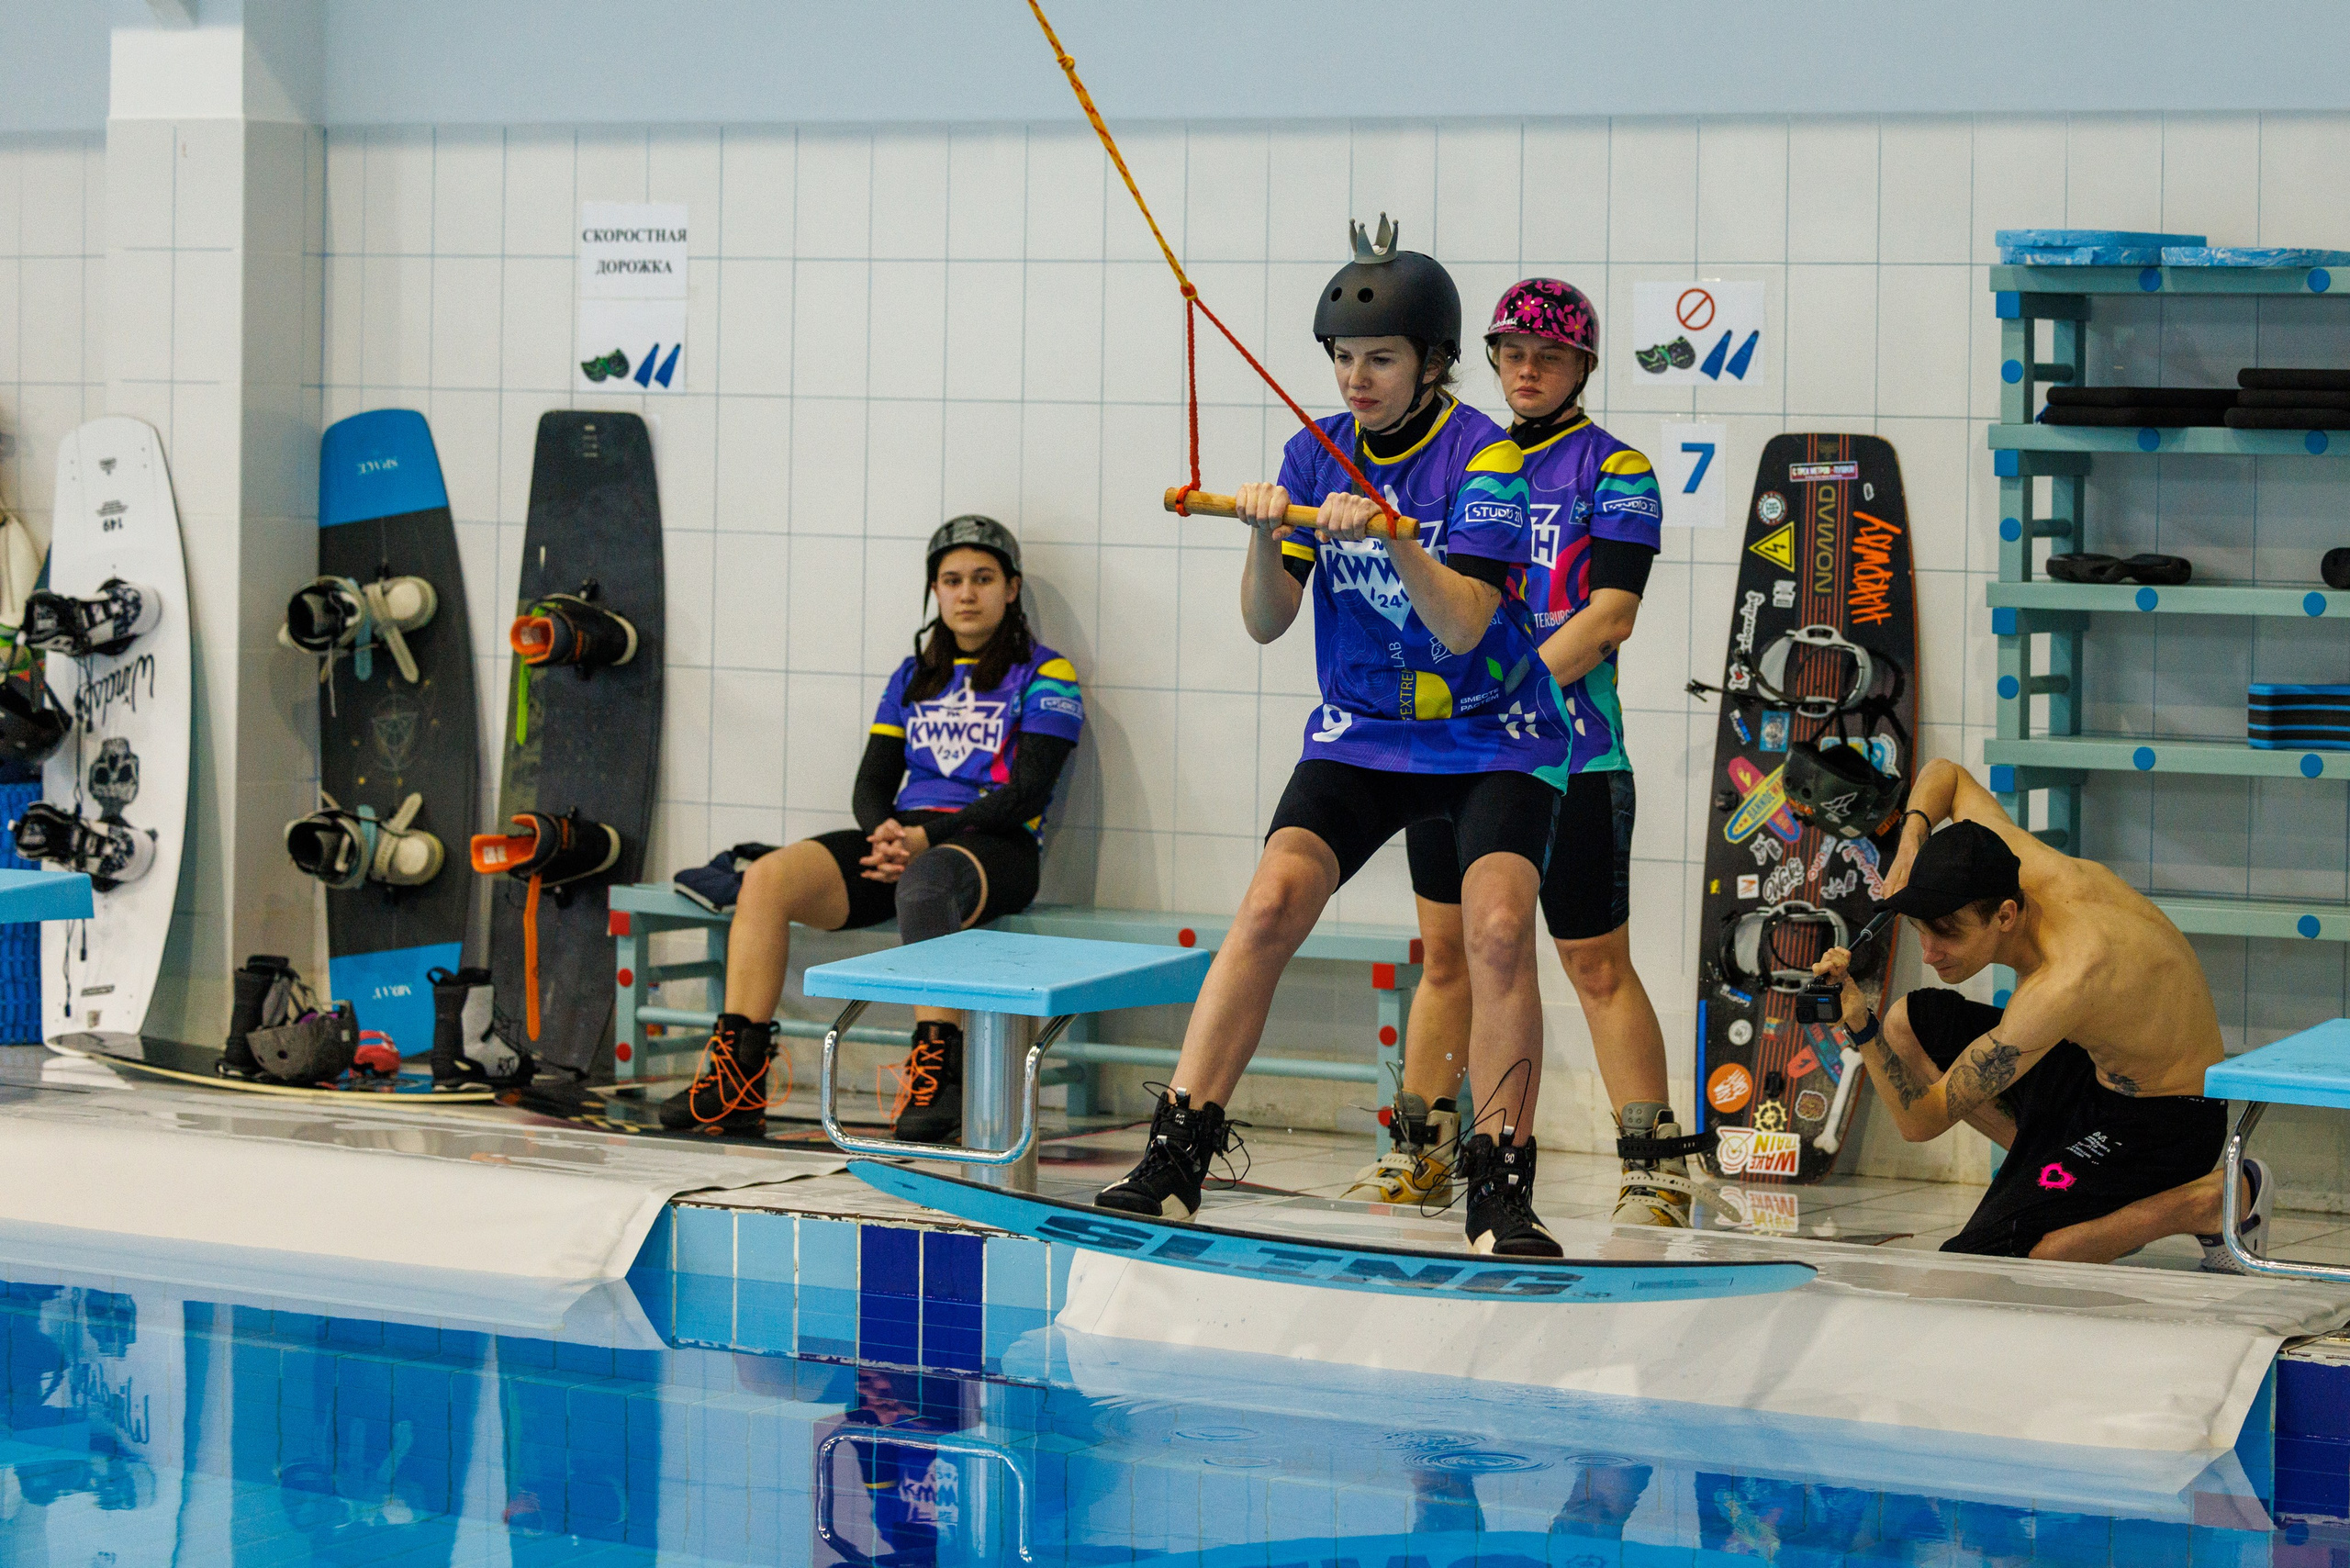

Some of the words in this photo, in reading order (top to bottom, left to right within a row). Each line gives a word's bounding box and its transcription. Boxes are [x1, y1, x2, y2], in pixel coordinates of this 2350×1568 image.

[582, 229, 688, 243] СКОРОСТНАЯ
[596, 259, 673, 274] ДОРОЖКА
[1681, 442, 1715, 494] 7
[1472, 506, 1514, 521] STUDIO
[1814, 485, 1836, 594] NOMAD
[1389, 642, 1405, 668] LAB
[910, 720, 1001, 749] KWWCH
[1752, 1134, 1797, 1154] TRAIN
[1749, 1150, 1796, 1172] WAKE
